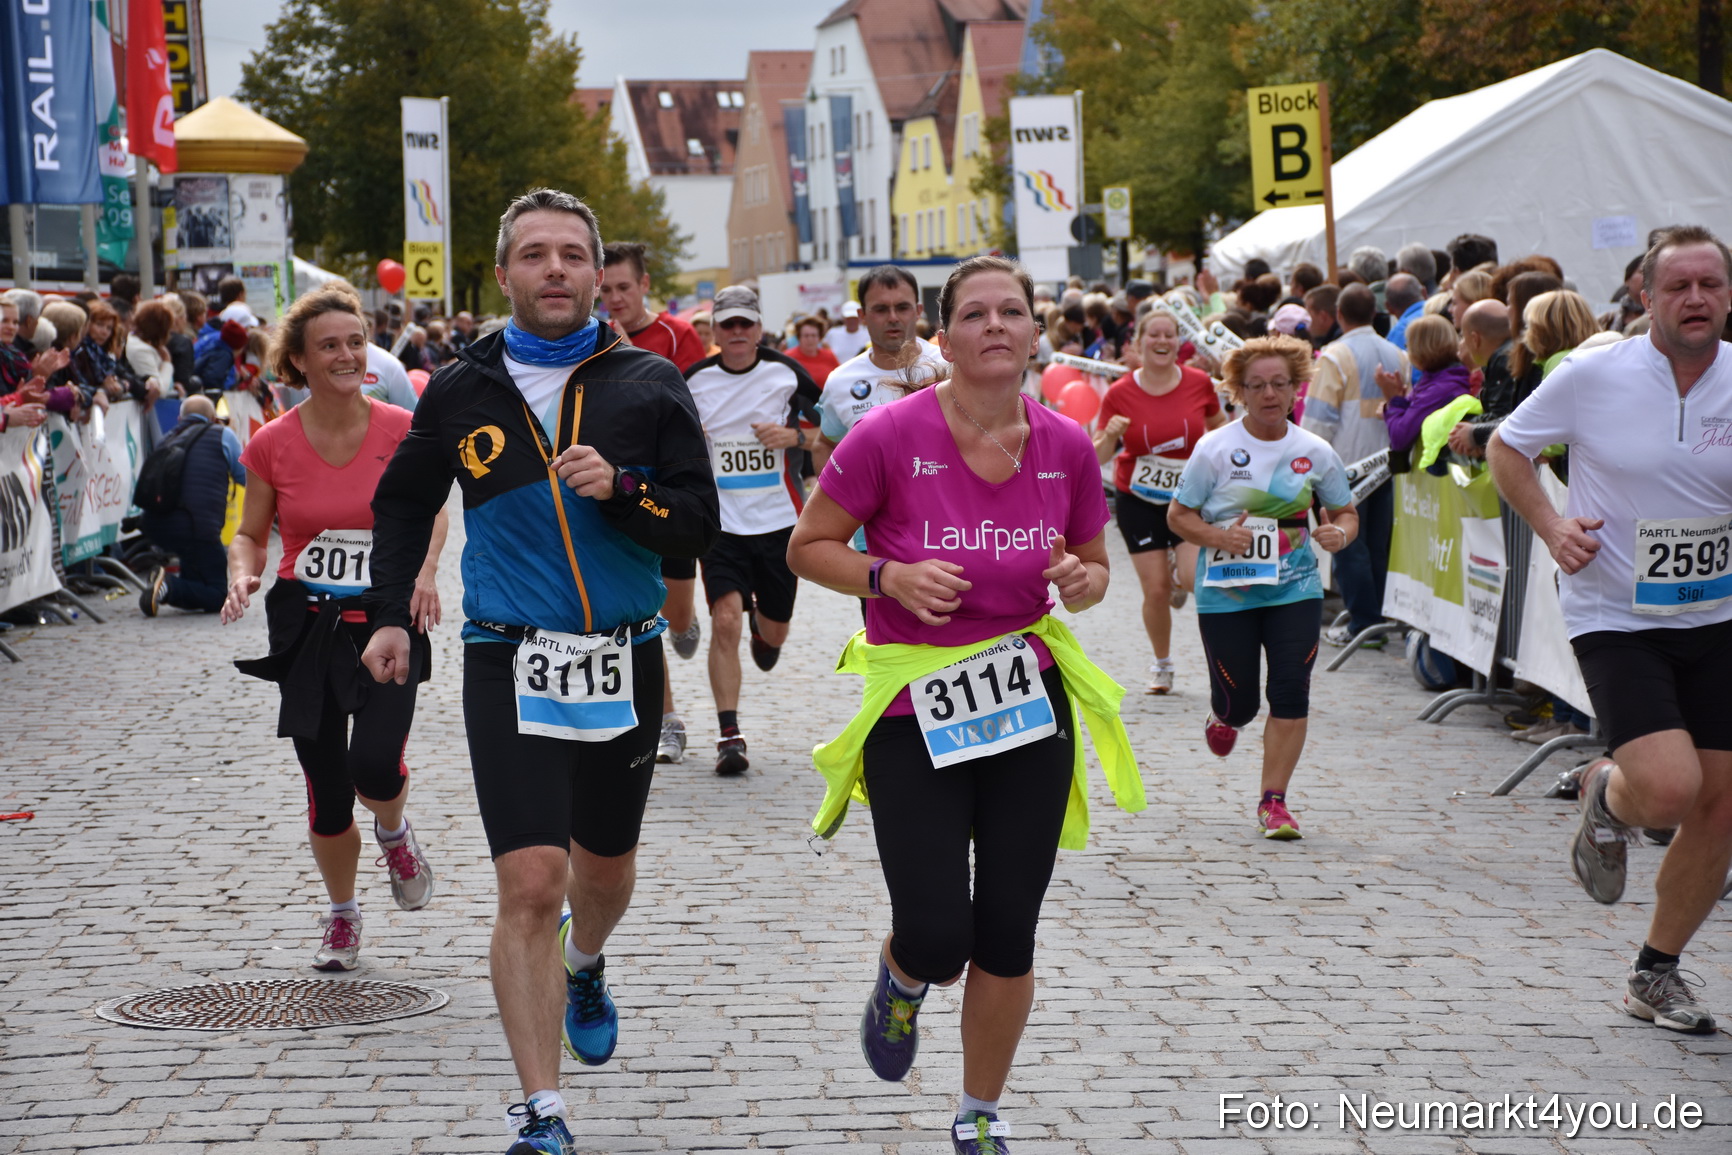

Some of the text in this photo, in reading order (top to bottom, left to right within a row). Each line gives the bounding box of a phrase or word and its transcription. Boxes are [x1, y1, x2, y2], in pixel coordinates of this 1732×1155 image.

[1258, 89, 1319, 114] Block
[1271, 123, 1311, 182] B
[408, 243, 438, 254] Block
[414, 259, 433, 285] C
[720, 448, 775, 473] 3056
[1362, 453, 1388, 473] BMW
[312, 535, 334, 544] RTL
[923, 519, 1059, 560] Laufperle
[1639, 524, 1727, 538] PARTL Neumarkt
[1647, 536, 1730, 578] 2593
[1222, 566, 1256, 577] Monika
[1677, 585, 1705, 602] Sigi
[524, 636, 562, 654] PARTL
[527, 653, 621, 696] 3115
[925, 655, 1031, 721] 3114
[946, 709, 1026, 747] VRONI
